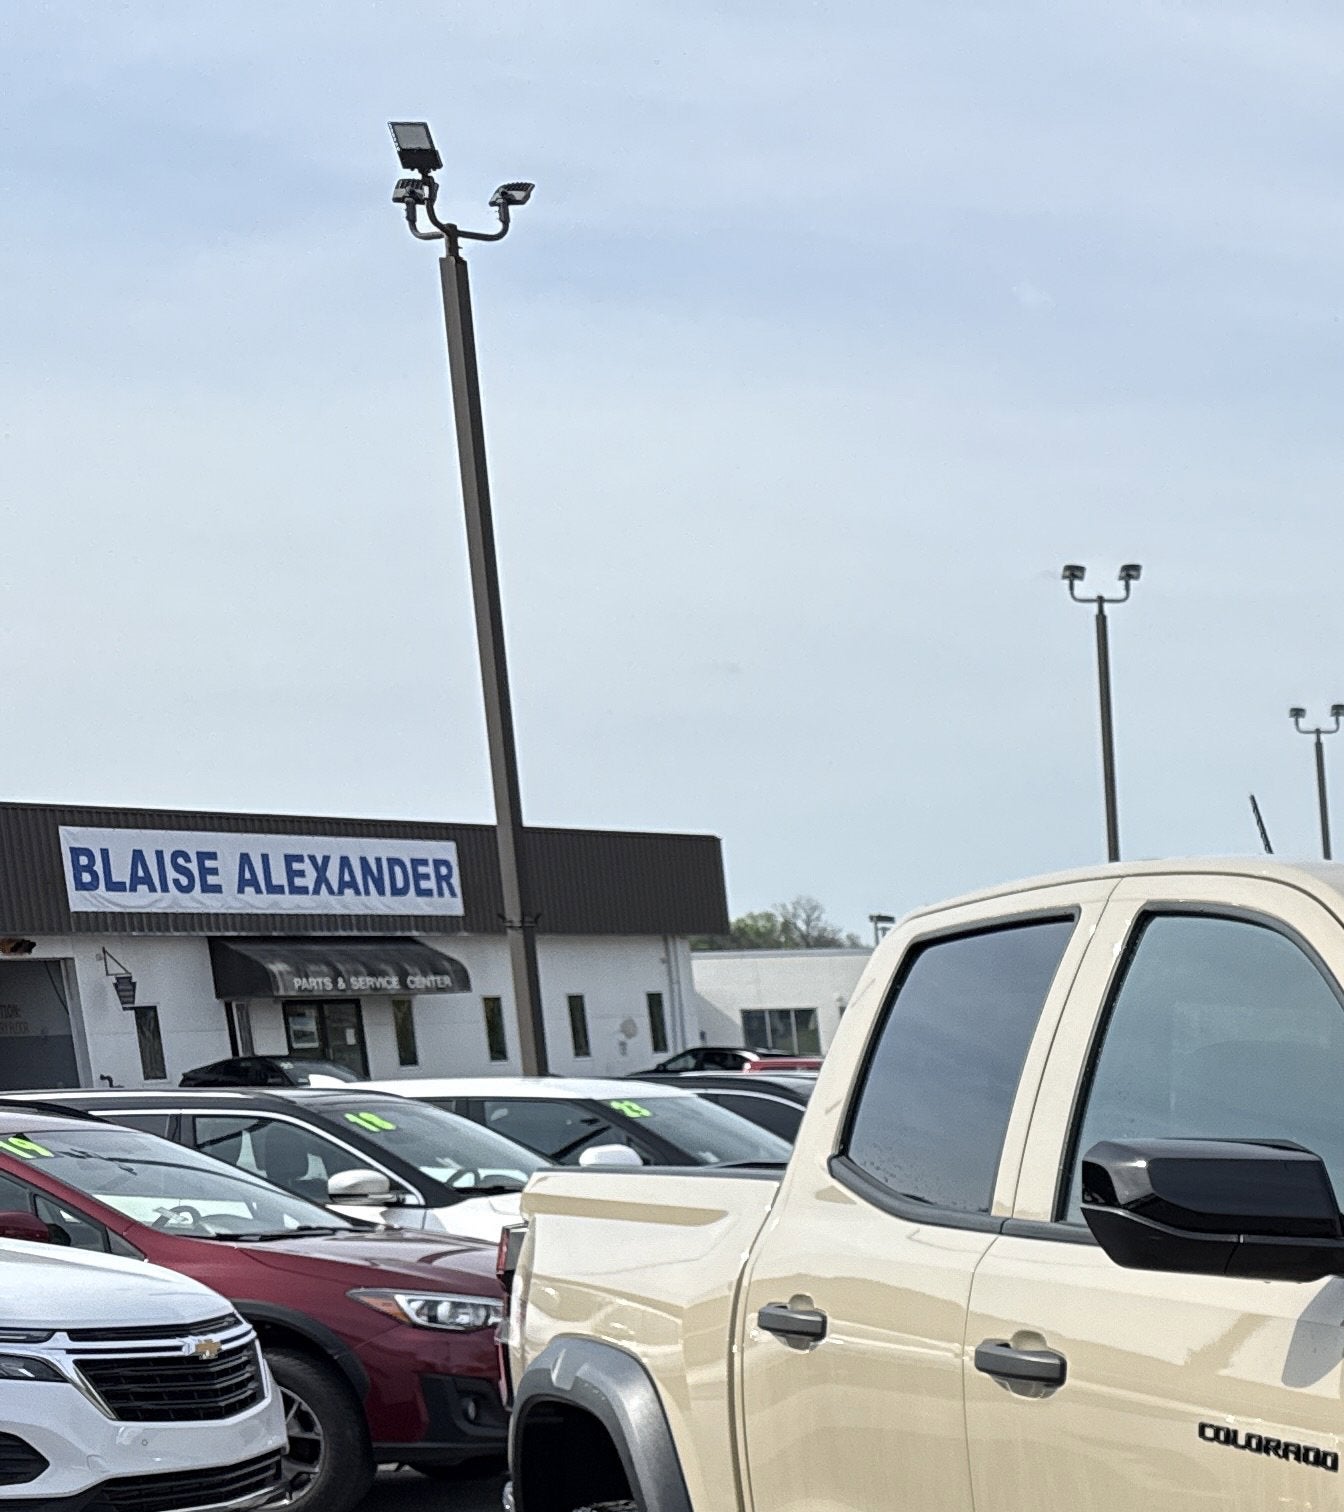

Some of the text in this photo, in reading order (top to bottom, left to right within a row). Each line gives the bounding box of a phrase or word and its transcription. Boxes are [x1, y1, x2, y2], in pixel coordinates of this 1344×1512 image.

[69, 845, 458, 899] BLAISE ALEXANDER
[293, 974, 453, 991] PARTS & SERVICE CENTER
[1197, 1421, 1339, 1473] COLORADO
